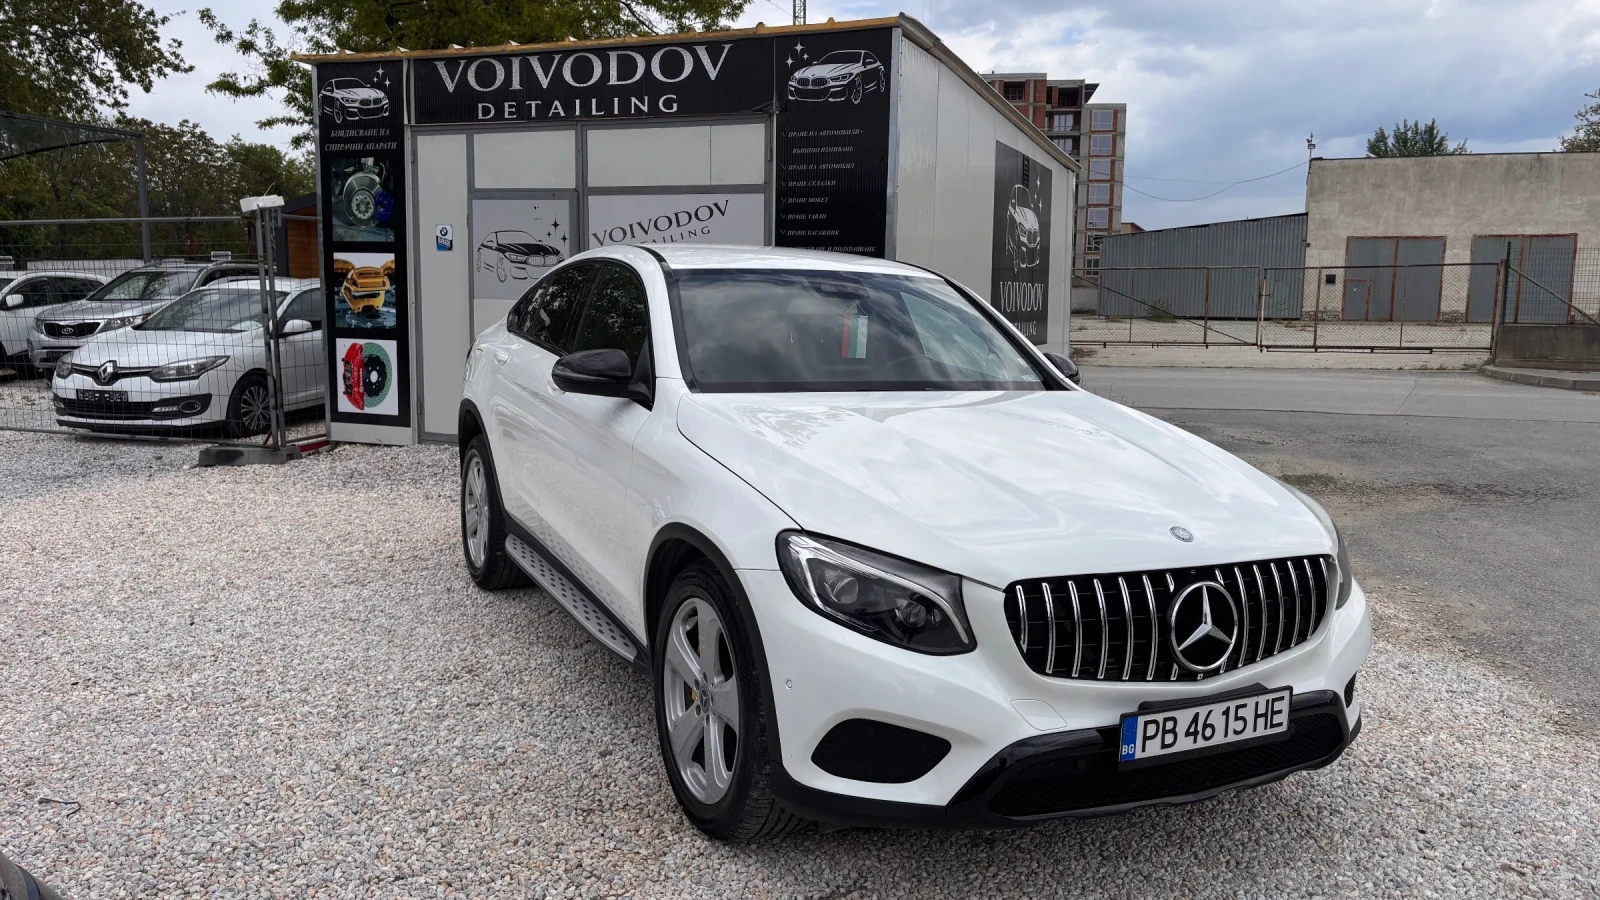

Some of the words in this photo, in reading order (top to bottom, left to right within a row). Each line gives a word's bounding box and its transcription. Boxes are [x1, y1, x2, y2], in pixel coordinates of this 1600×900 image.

[433, 44, 733, 93] VOIVODOV
[478, 95, 678, 120] DETAILING
[324, 143, 364, 151] СПИРАЧНИ
[364, 142, 398, 150] АПАРАТИ
[331, 129, 378, 138] БОЯДИСВАНЕ
[379, 128, 390, 136] НА
[591, 199, 730, 247] VOIVODOV
[1000, 281, 1044, 312] VOIVODOV
[1141, 716, 1178, 753] PB
[1184, 703, 1248, 744] 4615
[1252, 695, 1285, 733] HE
[1121, 744, 1135, 755] BG
